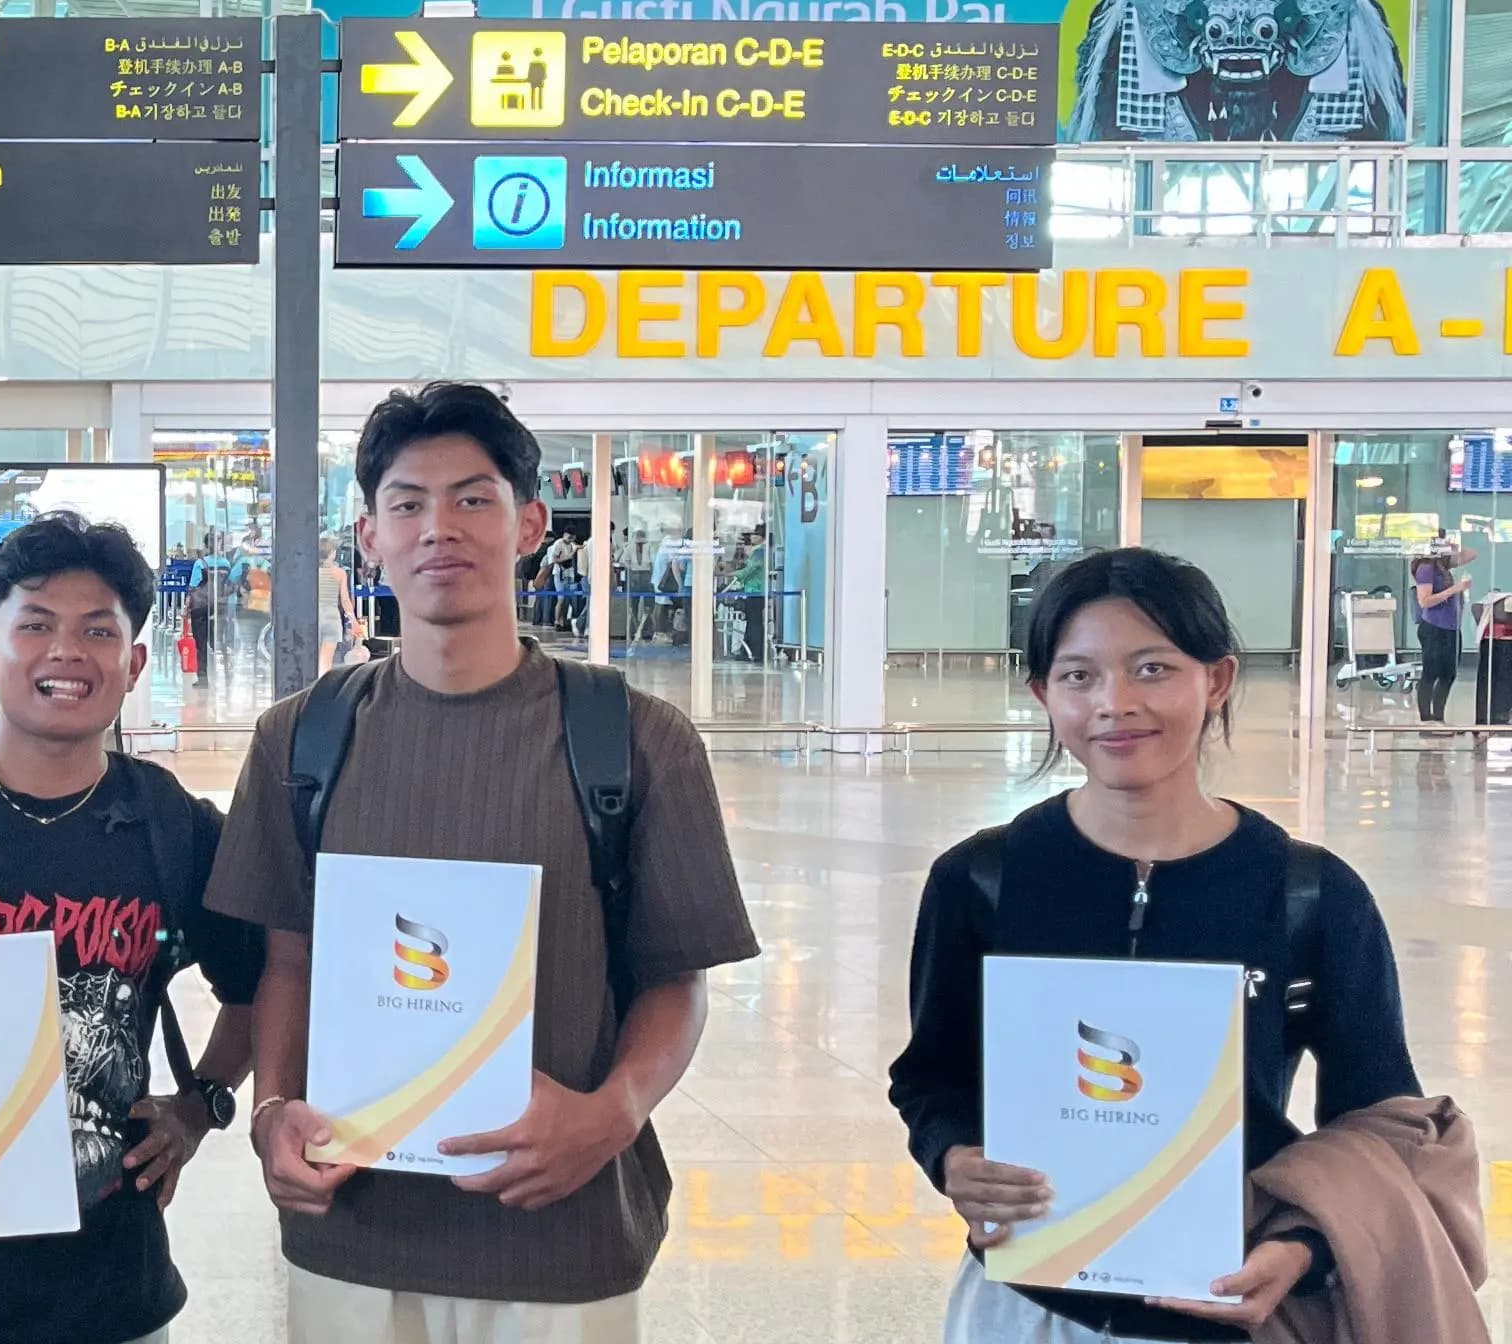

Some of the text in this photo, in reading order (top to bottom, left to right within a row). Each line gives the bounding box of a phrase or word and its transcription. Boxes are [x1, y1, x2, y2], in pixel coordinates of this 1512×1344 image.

[104, 38, 130, 52] B-A
[582, 36, 825, 71] Pelaporan C-D-E
[882, 43, 924, 58] E-D-C
[118, 58, 243, 75] 登机手续办理 A-B
[896, 63, 1038, 81] 登机手续办理 C-D-E
[110, 80, 243, 97] チェックイン A-B
[888, 85, 1037, 103] チェックイン C-D-E
[116, 104, 141, 119] B-A
[580, 88, 806, 118] Check-In C-D-E
[888, 110, 932, 126] E-D-C
[584, 161, 714, 189] Informasi
[210, 183, 242, 200] 出发
[583, 213, 742, 241] Information
[530, 268, 1250, 358] DEPARTURE
[377, 995, 464, 1014] BIG HIRING
[1059, 1108, 1160, 1127] BIG HIRING
